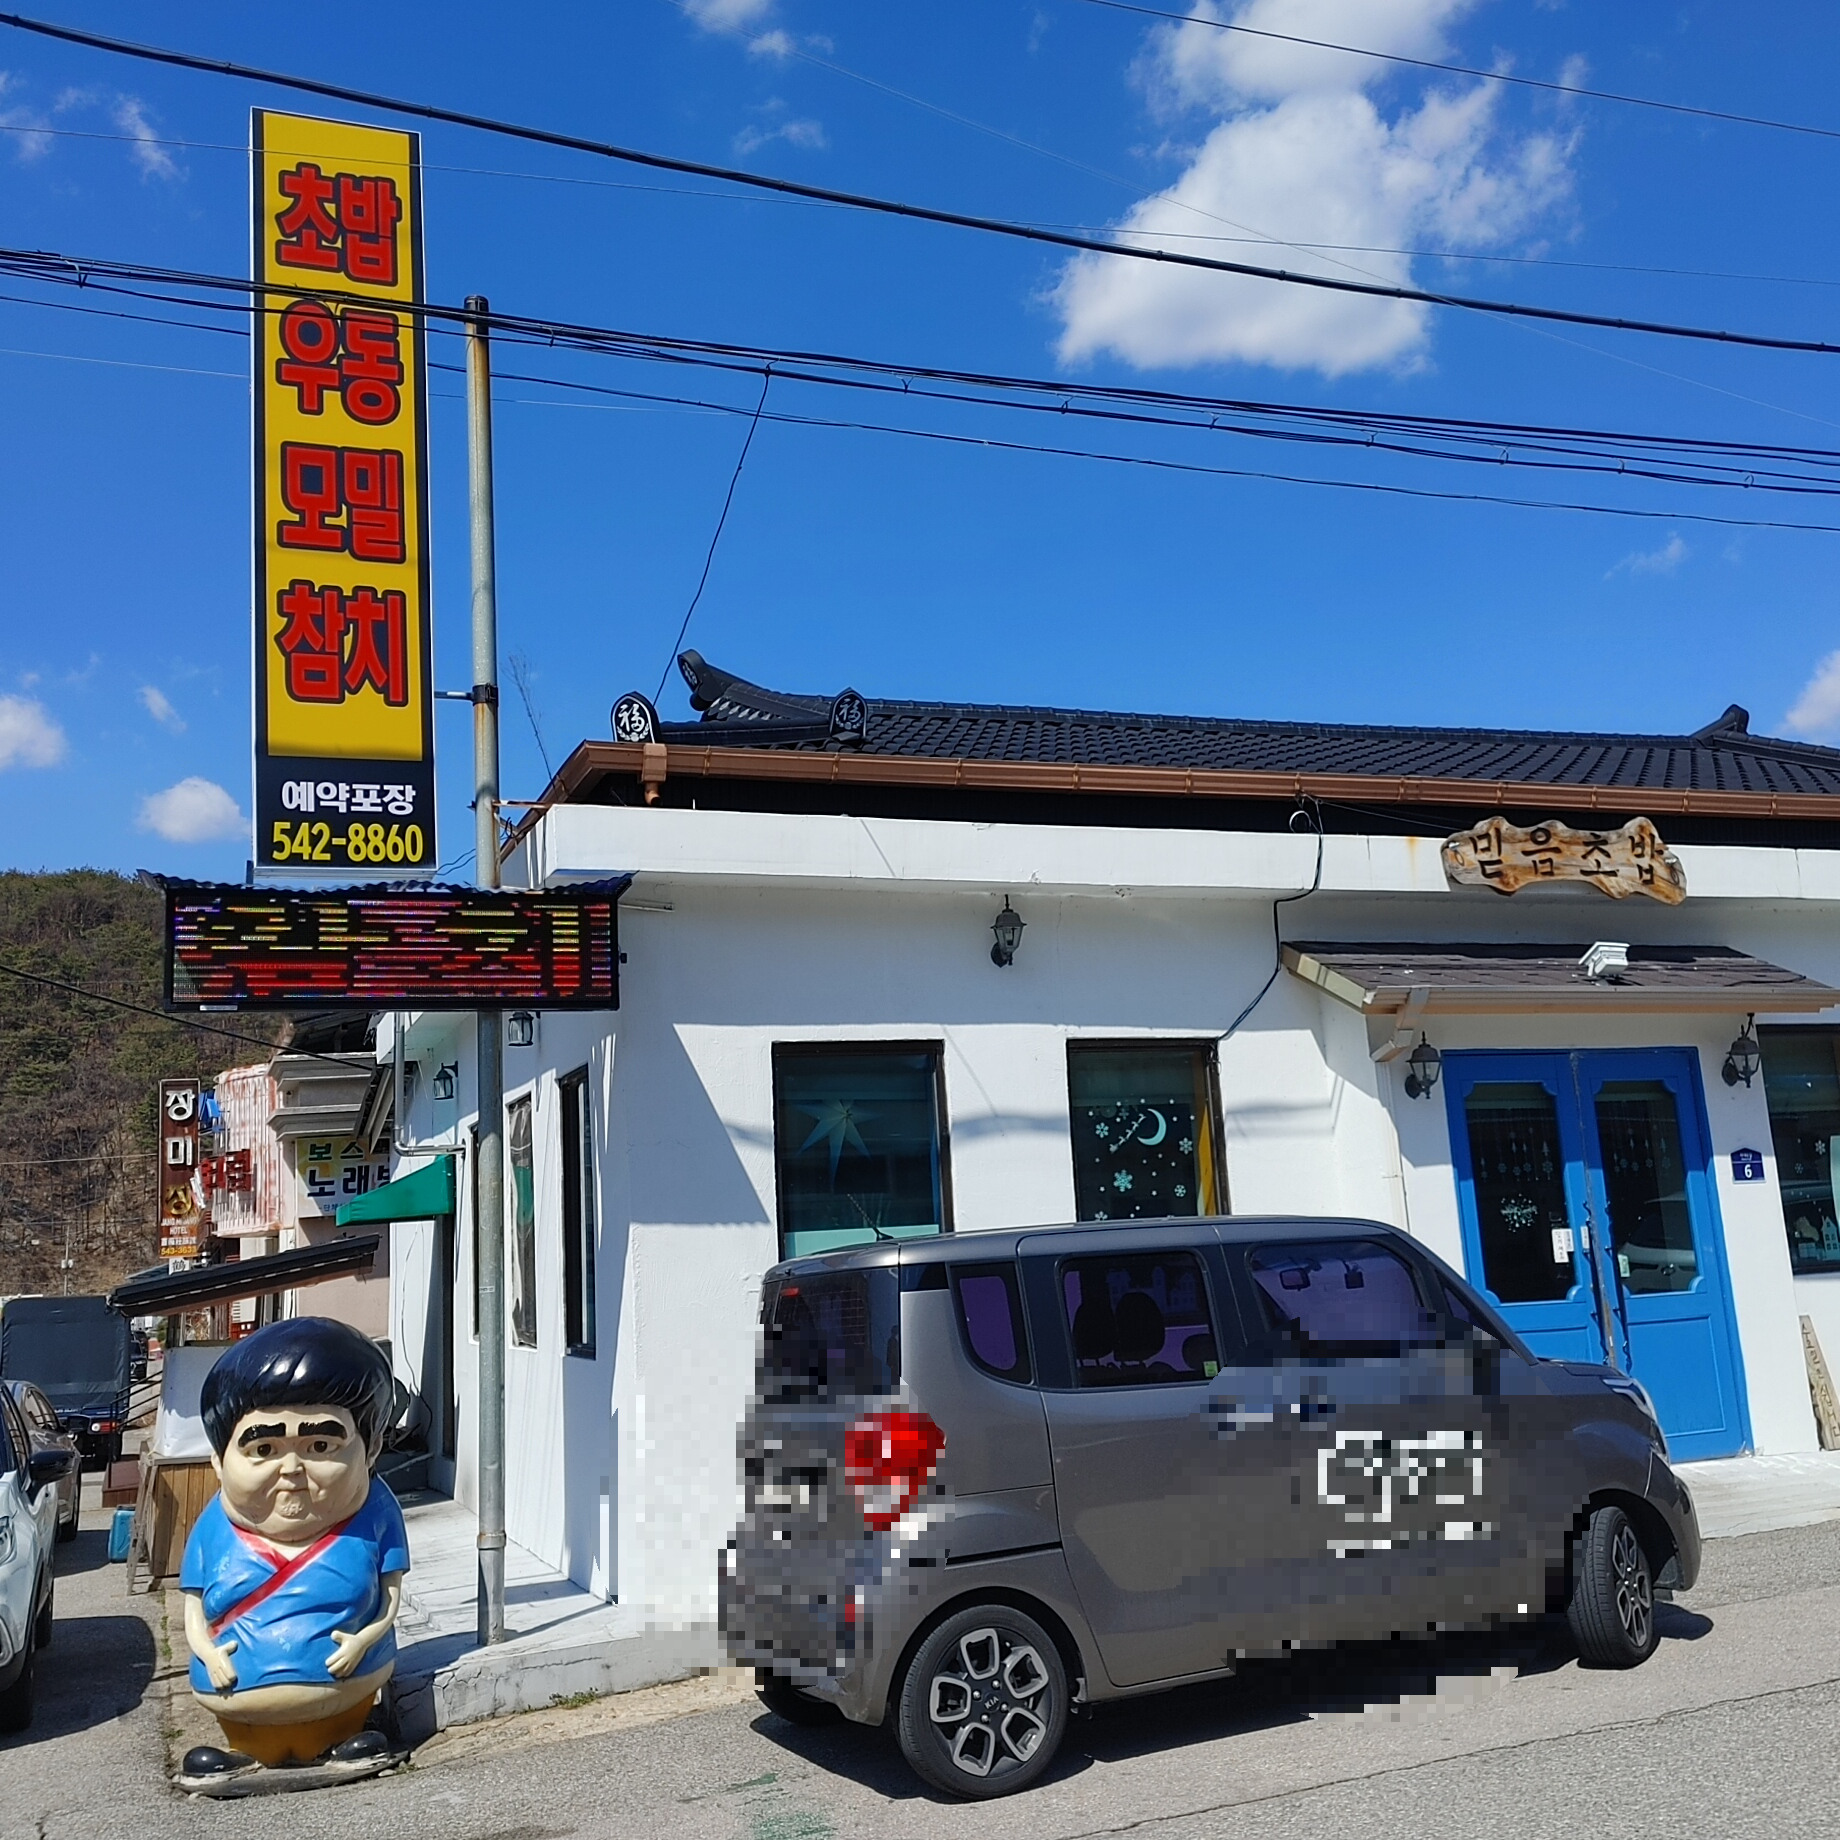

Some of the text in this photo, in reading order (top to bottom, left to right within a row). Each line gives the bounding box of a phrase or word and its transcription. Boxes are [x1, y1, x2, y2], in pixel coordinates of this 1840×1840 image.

[276, 163, 402, 287] 초밥
[276, 302, 404, 425] 우동
[278, 442, 406, 564] 모밀
[275, 579, 409, 707] 참치
[281, 781, 416, 816] 예약포장
[272, 822, 423, 863] 542-8860
[308, 1141, 364, 1161] 보스
[1744, 1164, 1752, 1178] 6
[169, 1226, 188, 1236] HOTEL
[985, 1696, 999, 1709] KIA
